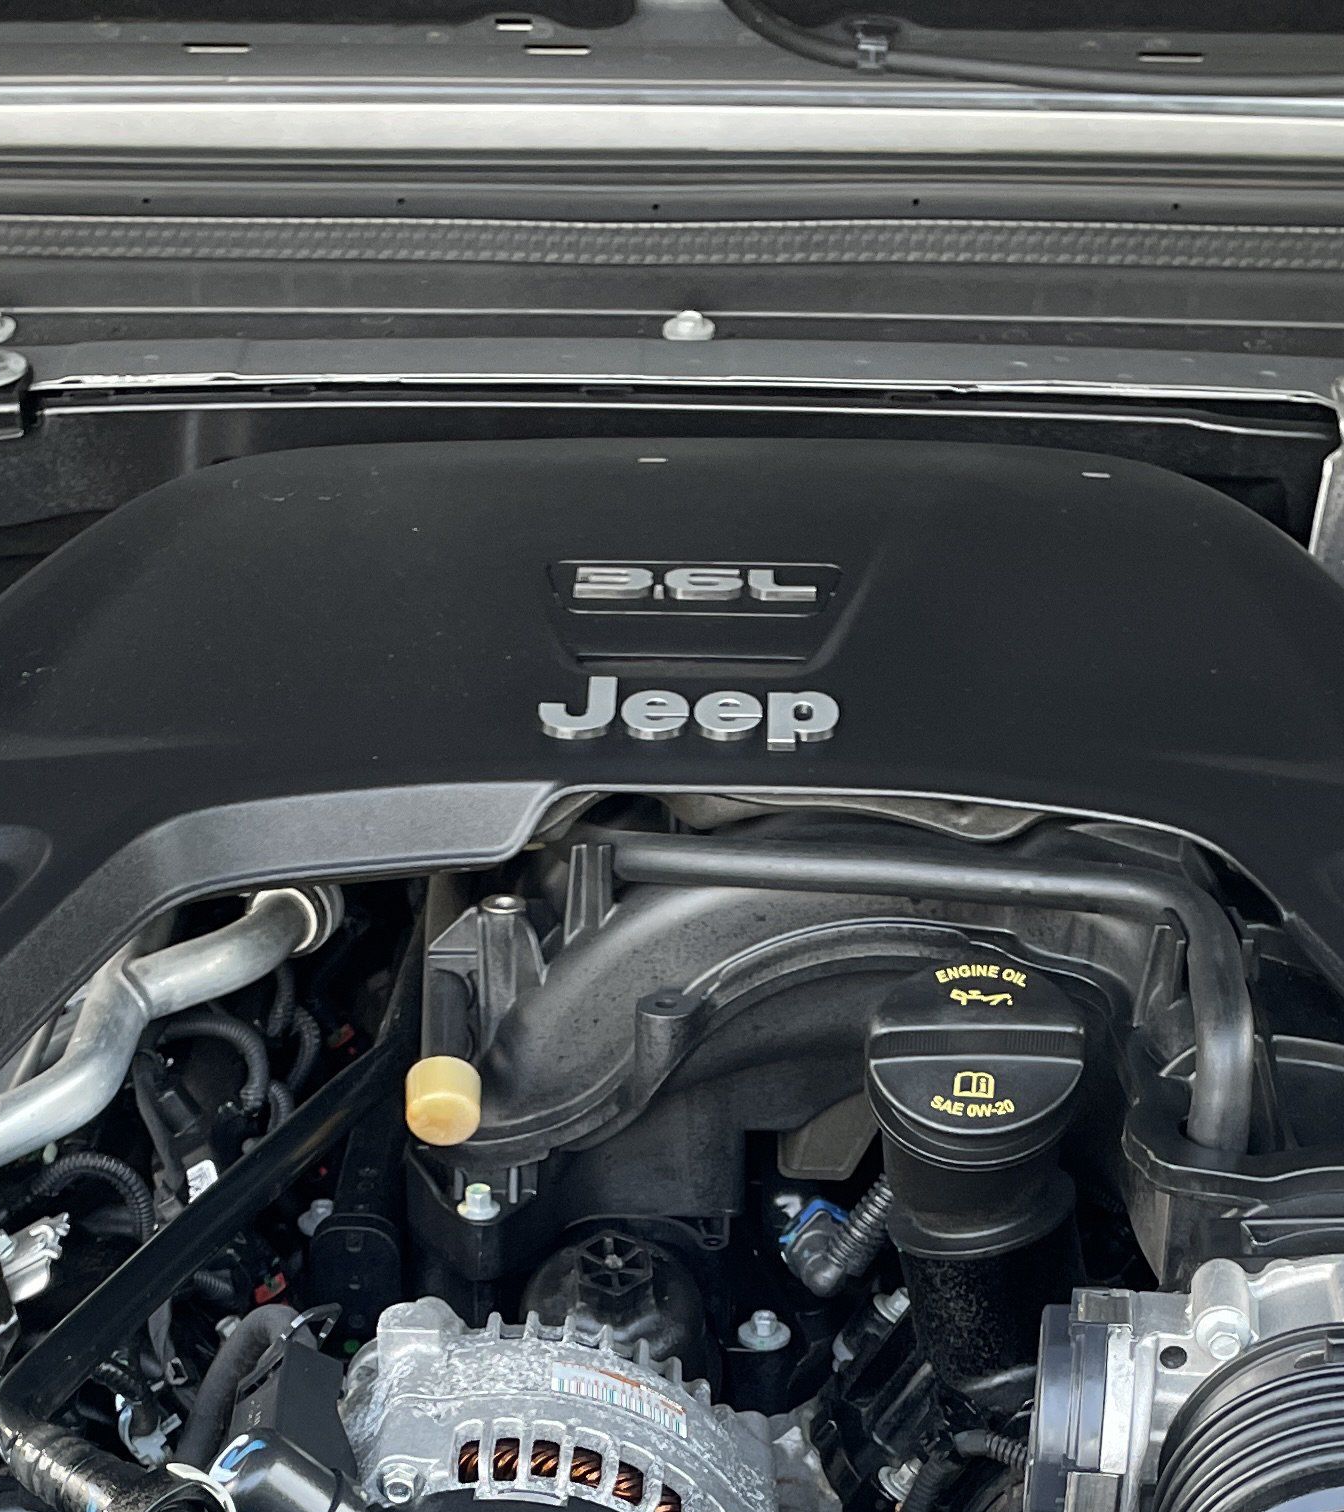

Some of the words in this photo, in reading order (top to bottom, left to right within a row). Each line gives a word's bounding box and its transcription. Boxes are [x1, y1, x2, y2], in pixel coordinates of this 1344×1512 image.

[572, 566, 817, 602] 3.6L
[537, 675, 840, 752] Jeep
[934, 964, 1000, 984] ENGINE
[1002, 968, 1028, 988] OIL
[930, 1095, 965, 1117] SAE
[966, 1099, 1016, 1118] 0W-20
